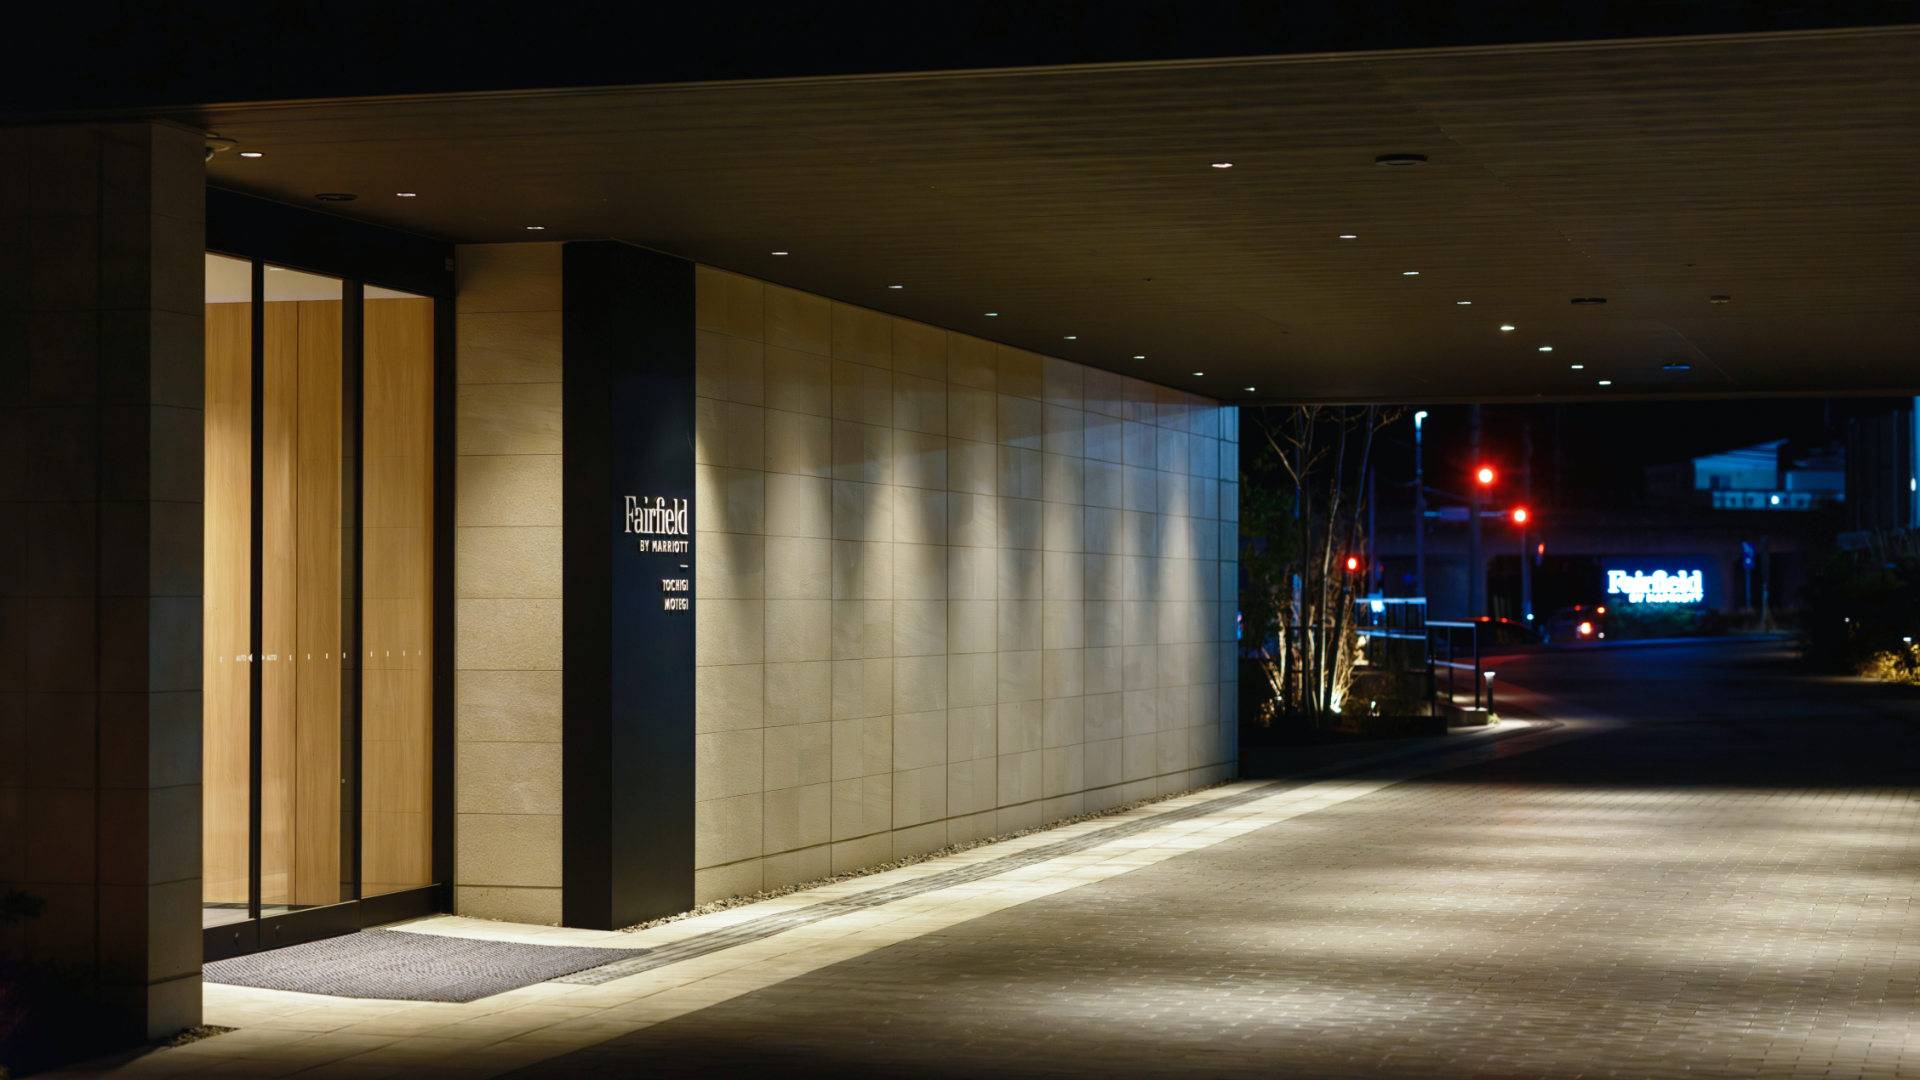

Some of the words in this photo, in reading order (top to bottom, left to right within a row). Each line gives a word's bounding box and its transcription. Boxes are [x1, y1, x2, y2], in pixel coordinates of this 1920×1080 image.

[624, 495, 689, 535] Fairfield
[640, 540, 650, 552] BY
[651, 541, 689, 553] MARRIOTT
[662, 579, 689, 591] TOCHIGI
[1607, 569, 1703, 594] Fairfield
[664, 598, 689, 610] MOTEGI
